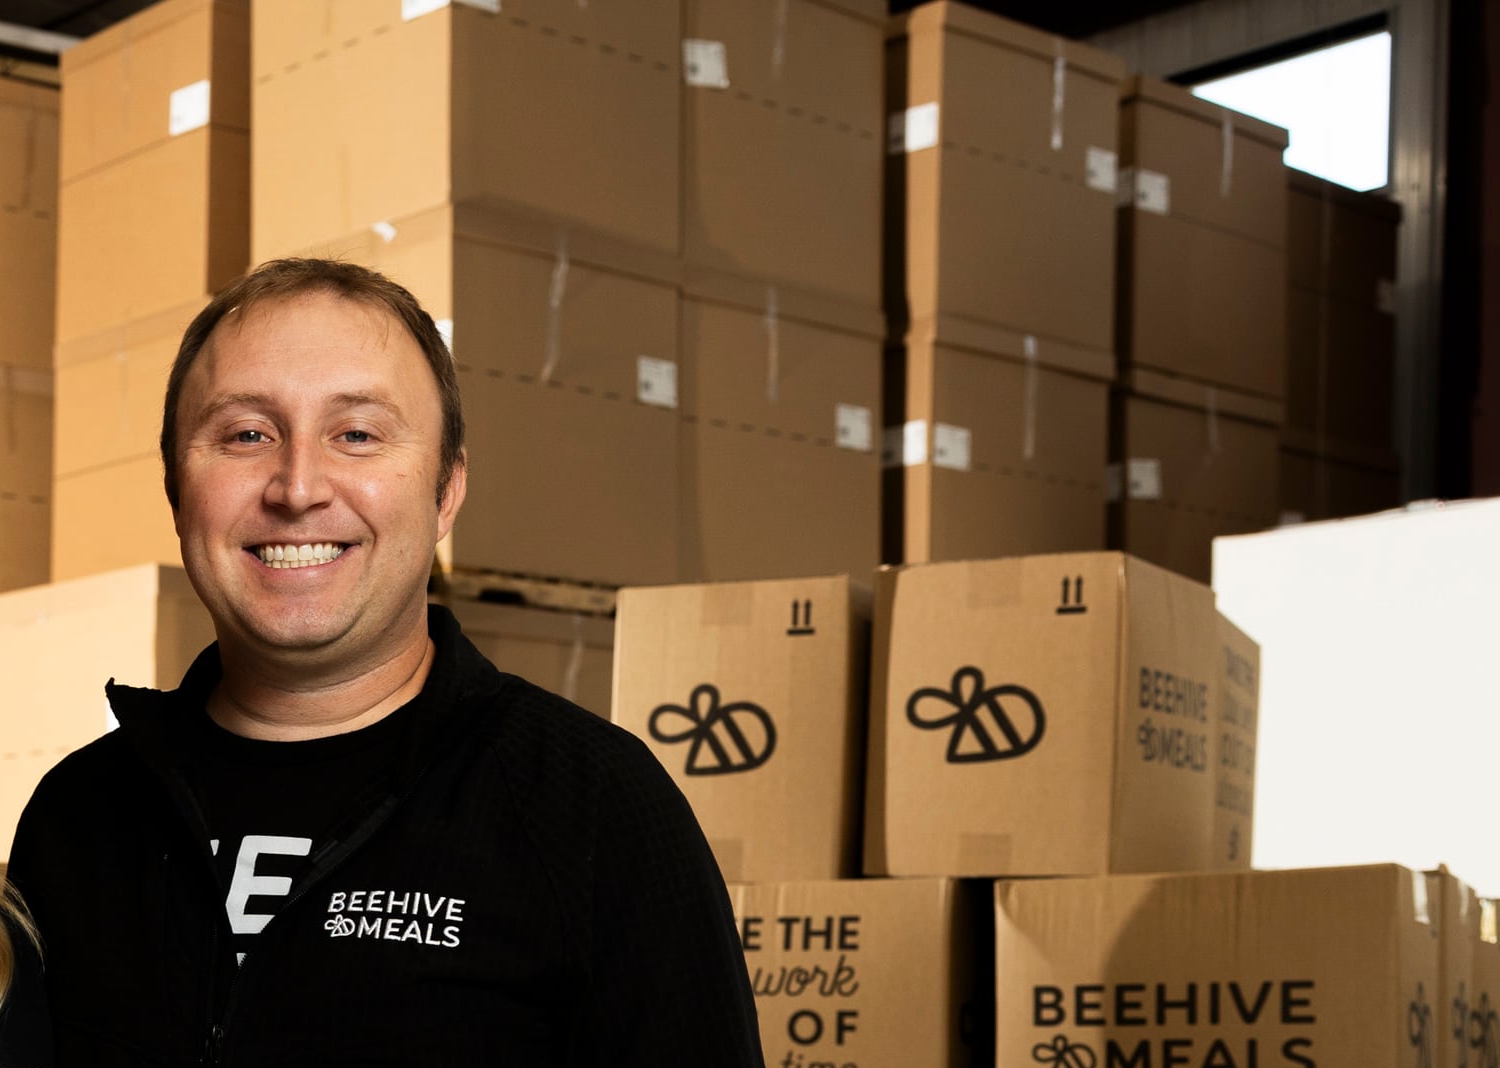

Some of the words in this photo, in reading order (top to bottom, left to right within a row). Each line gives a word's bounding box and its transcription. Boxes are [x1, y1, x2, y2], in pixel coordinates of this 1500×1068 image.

[1140, 666, 1207, 724] BEEHIVE
[327, 890, 466, 922] BEEHIVE
[357, 916, 461, 948] MEALS
[777, 915, 861, 951] THE
[754, 955, 861, 997] work
[1033, 981, 1317, 1027] BEEHIVE
[787, 1010, 860, 1046] OF
